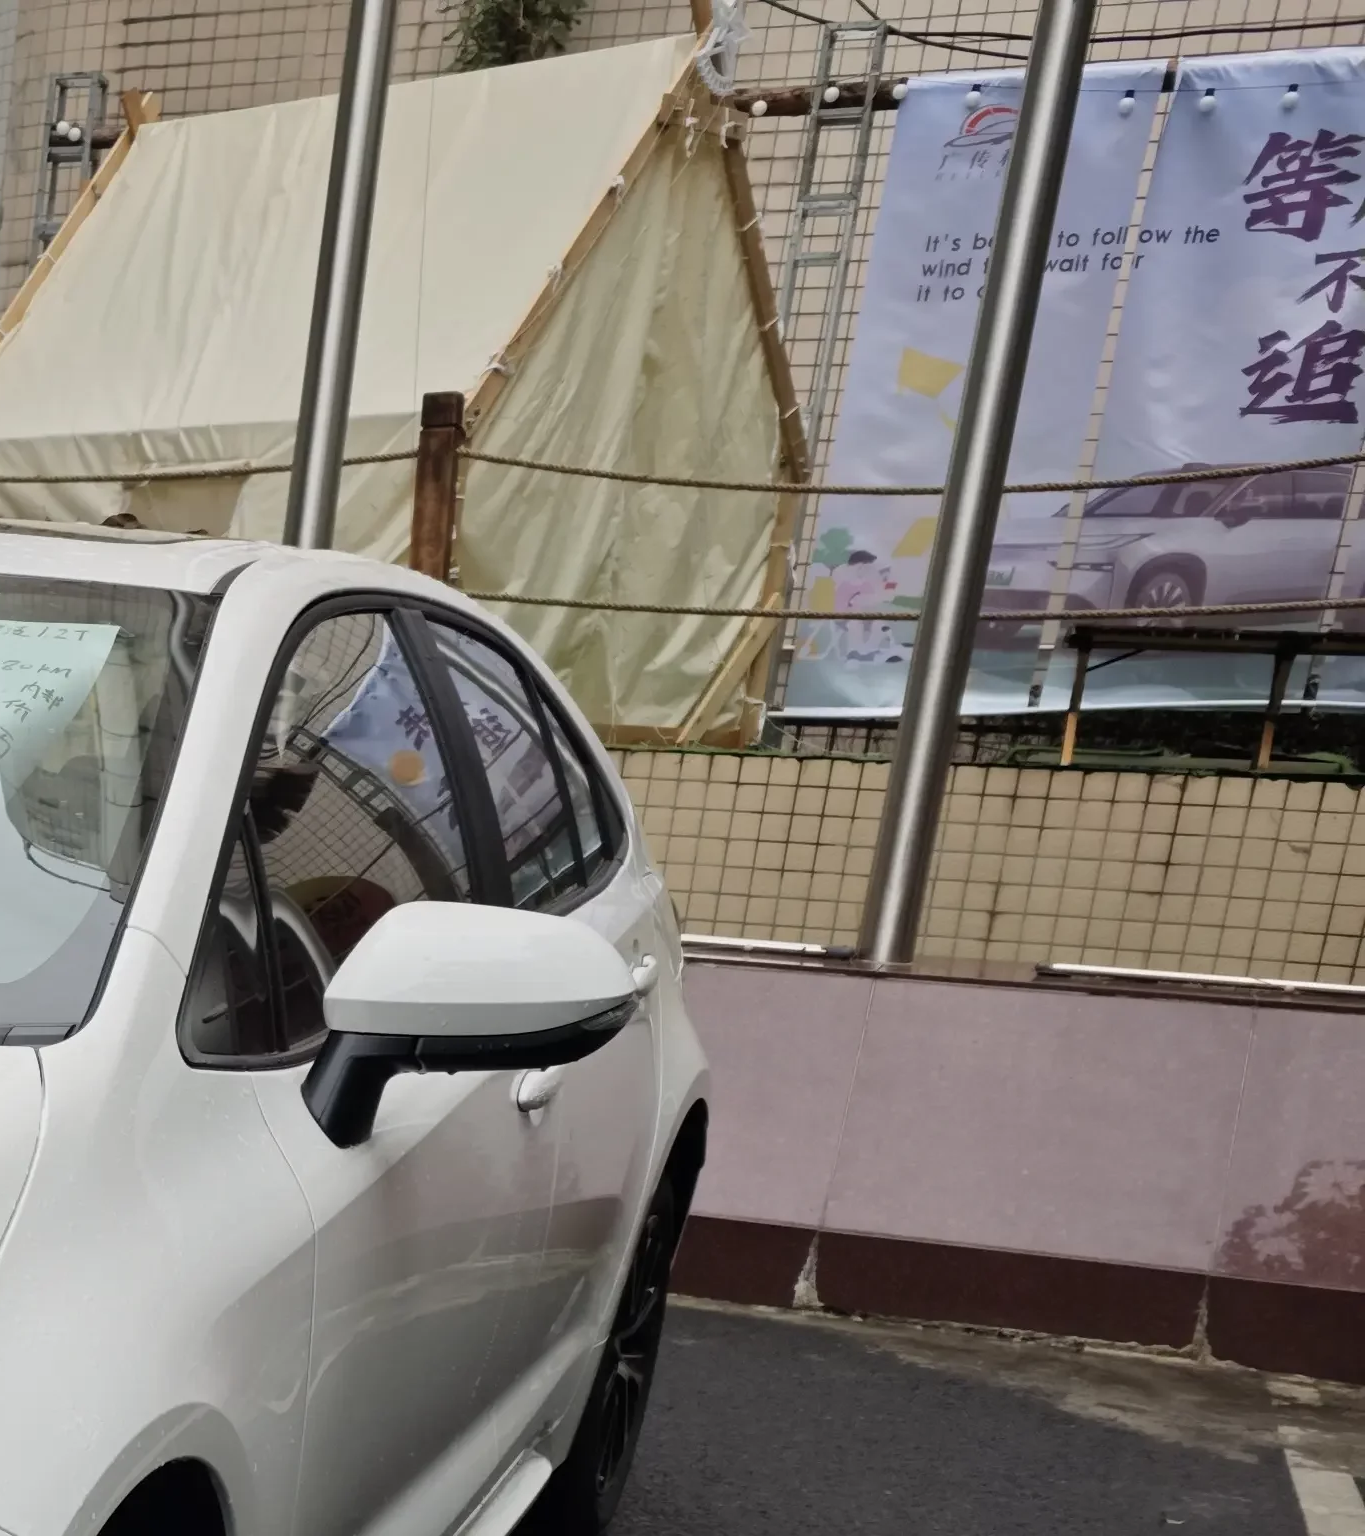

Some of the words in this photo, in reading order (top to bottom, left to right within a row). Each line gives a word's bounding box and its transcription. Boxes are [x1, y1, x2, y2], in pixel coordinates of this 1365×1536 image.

[925, 233, 961, 253] It's
[1057, 230, 1080, 248] to
[1183, 225, 1220, 244] the
[922, 257, 972, 278] wind
[1045, 254, 1089, 273] wait
[916, 284, 931, 302] it
[943, 284, 965, 302] to
